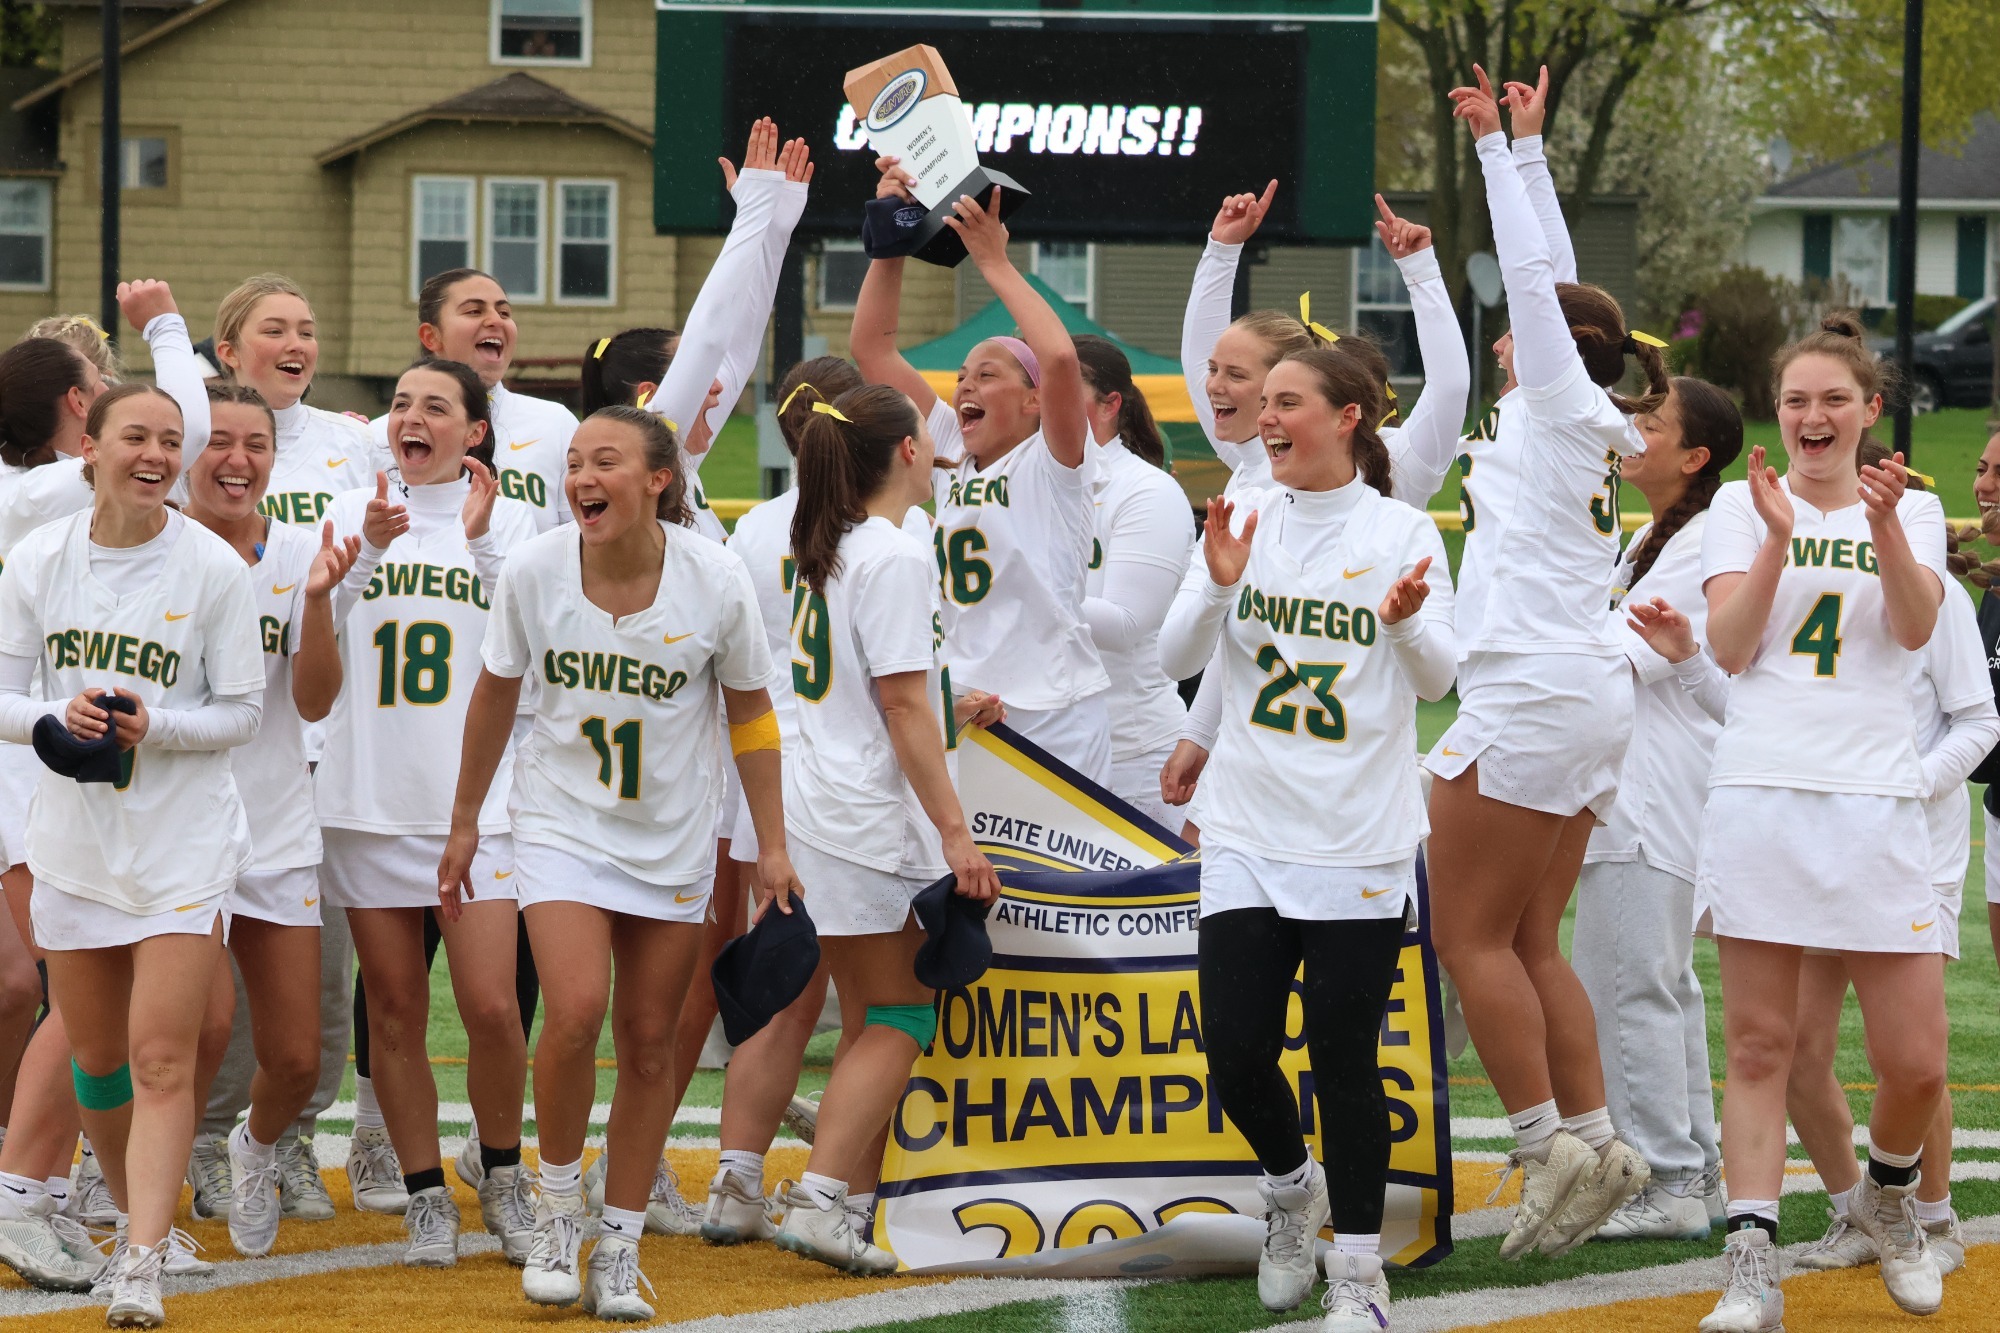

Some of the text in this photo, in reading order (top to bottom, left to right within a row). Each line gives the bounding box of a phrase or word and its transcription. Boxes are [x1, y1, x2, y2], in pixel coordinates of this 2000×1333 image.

[833, 102, 1202, 156] CMPIONS!!
[906, 124, 933, 152] WOMEN'S
[912, 134, 937, 161] LACROSSE
[917, 148, 949, 180] CHAMPIONS
[935, 173, 949, 188] 2025
[1782, 537, 1880, 577] WEG
[362, 563, 490, 611] SWEGO
[1237, 584, 1377, 647] OSWEGO
[1789, 592, 1844, 679] 4
[46, 628, 181, 689] OSWEGO
[373, 620, 454, 708] 18
[544, 648, 688, 701] OSWEGO
[1249, 643, 1348, 743] 23
[580, 715, 643, 801] 11
[971, 811, 1043, 847] STATE
[996, 902, 1199, 937] ATHLETIC CONFE
